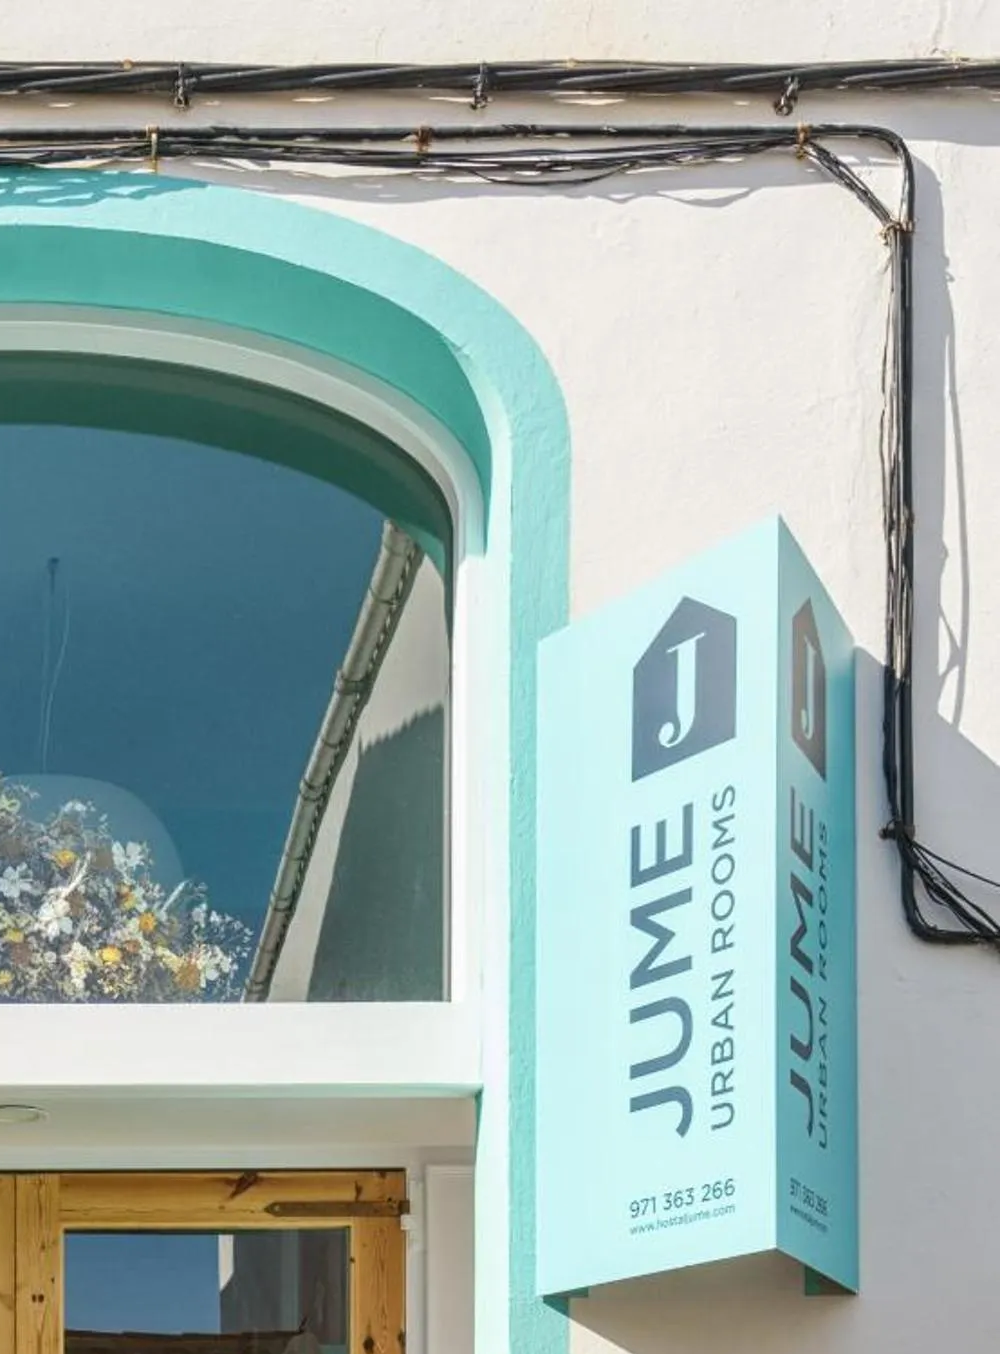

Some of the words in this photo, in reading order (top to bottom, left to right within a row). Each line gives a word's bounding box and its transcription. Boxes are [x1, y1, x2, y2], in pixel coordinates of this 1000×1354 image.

[658, 632, 706, 748] J
[800, 634, 817, 740] J
[711, 785, 736, 954] ROOMS
[819, 820, 828, 981] ROOMS
[630, 802, 693, 1138] JUME
[790, 786, 814, 1138] JUME
[711, 969, 735, 1131] URBAN
[819, 996, 828, 1149] URBAN
[629, 1196, 656, 1219] 971
[663, 1187, 694, 1211] 363
[701, 1178, 735, 1202] 266
